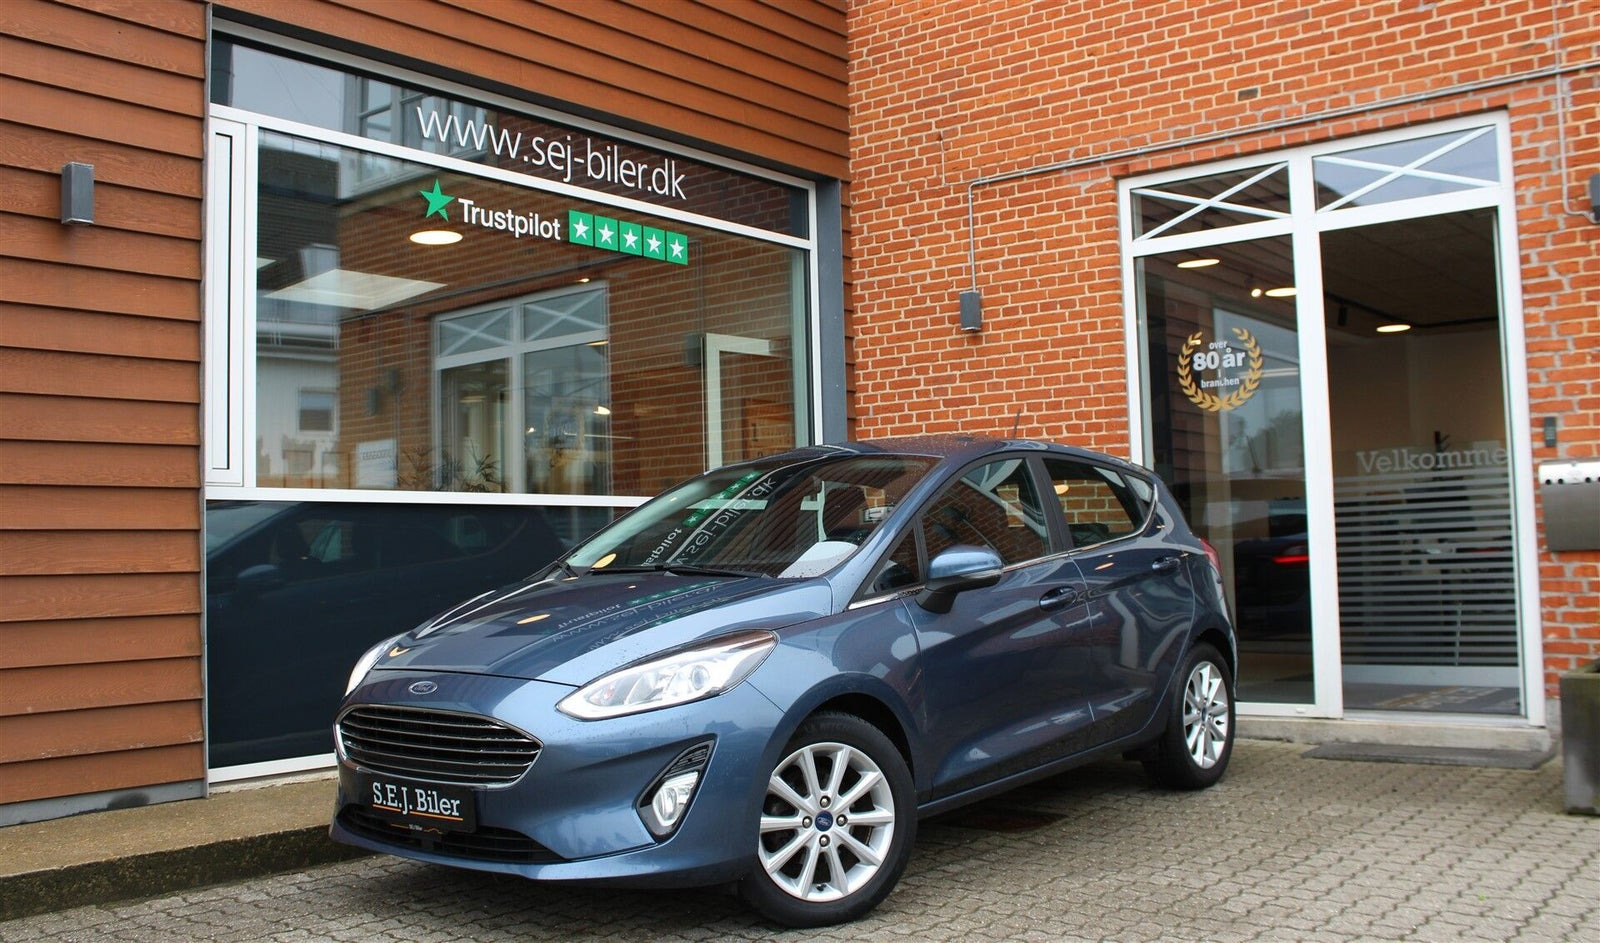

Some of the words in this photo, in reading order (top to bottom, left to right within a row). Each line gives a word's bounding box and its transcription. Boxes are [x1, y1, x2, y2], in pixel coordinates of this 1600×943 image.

[416, 105, 688, 201] www.sej-biler.dk
[457, 197, 562, 242] Trustpilot
[1192, 350, 1220, 371] 80
[1222, 347, 1246, 368] år
[1209, 340, 1229, 350] over
[372, 781, 413, 815] S.E.J.
[415, 788, 460, 817] Biler
